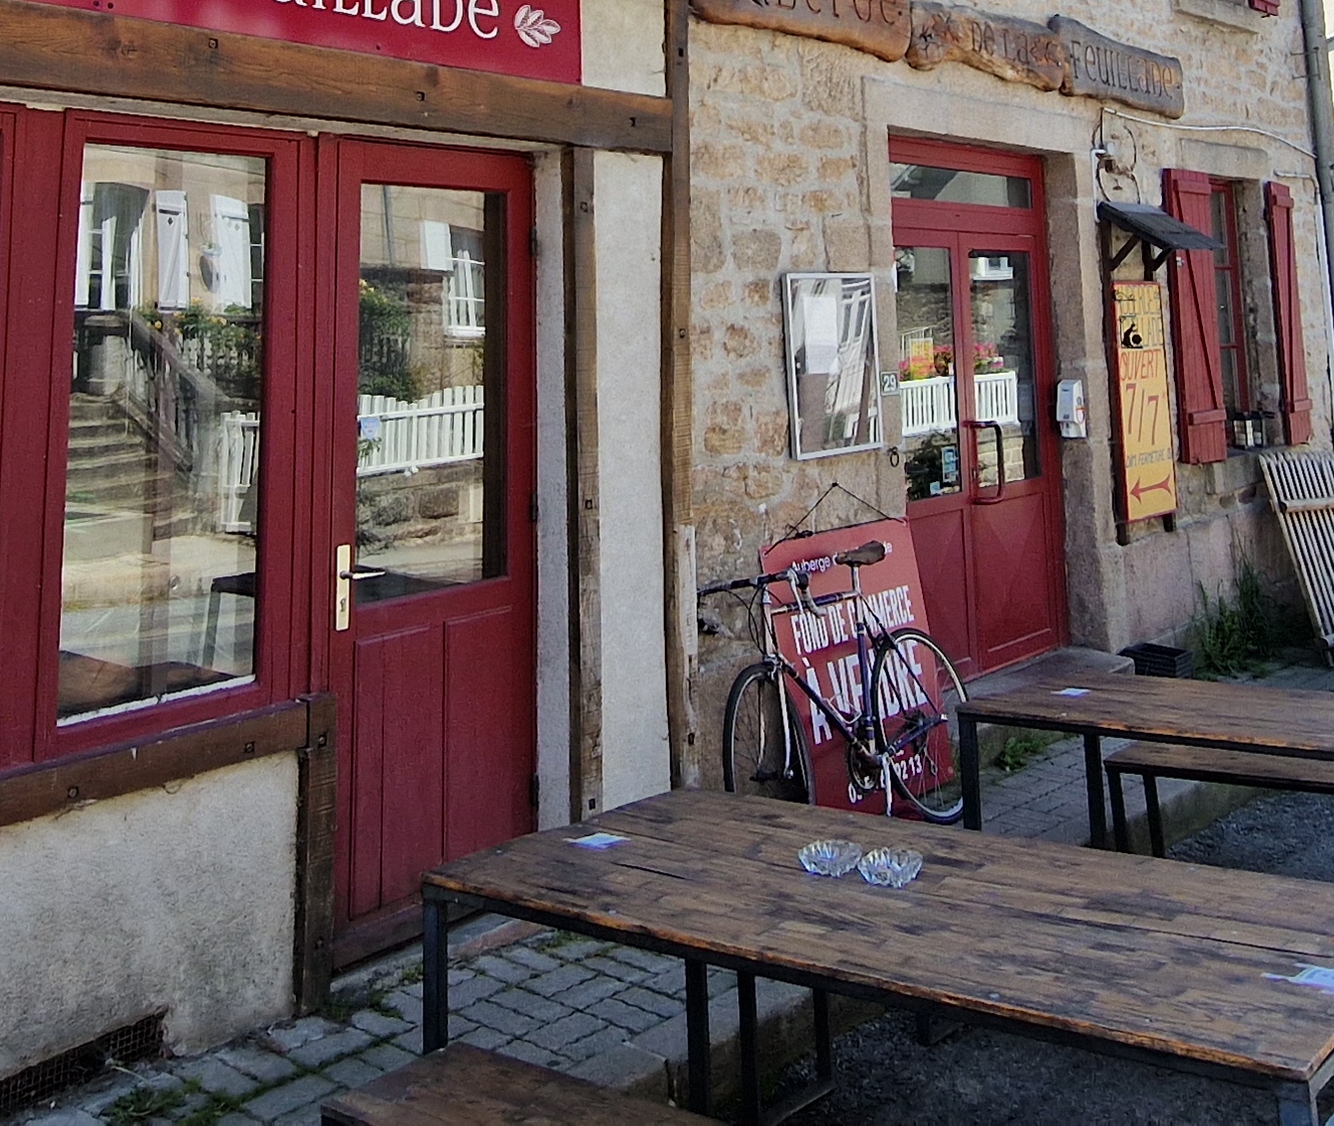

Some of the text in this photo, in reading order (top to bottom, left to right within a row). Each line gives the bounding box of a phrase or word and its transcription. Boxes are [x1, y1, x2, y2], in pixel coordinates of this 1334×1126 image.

[1120, 349, 1162, 382] OUVERT
[882, 375, 898, 392] 29
[827, 604, 850, 645] DE
